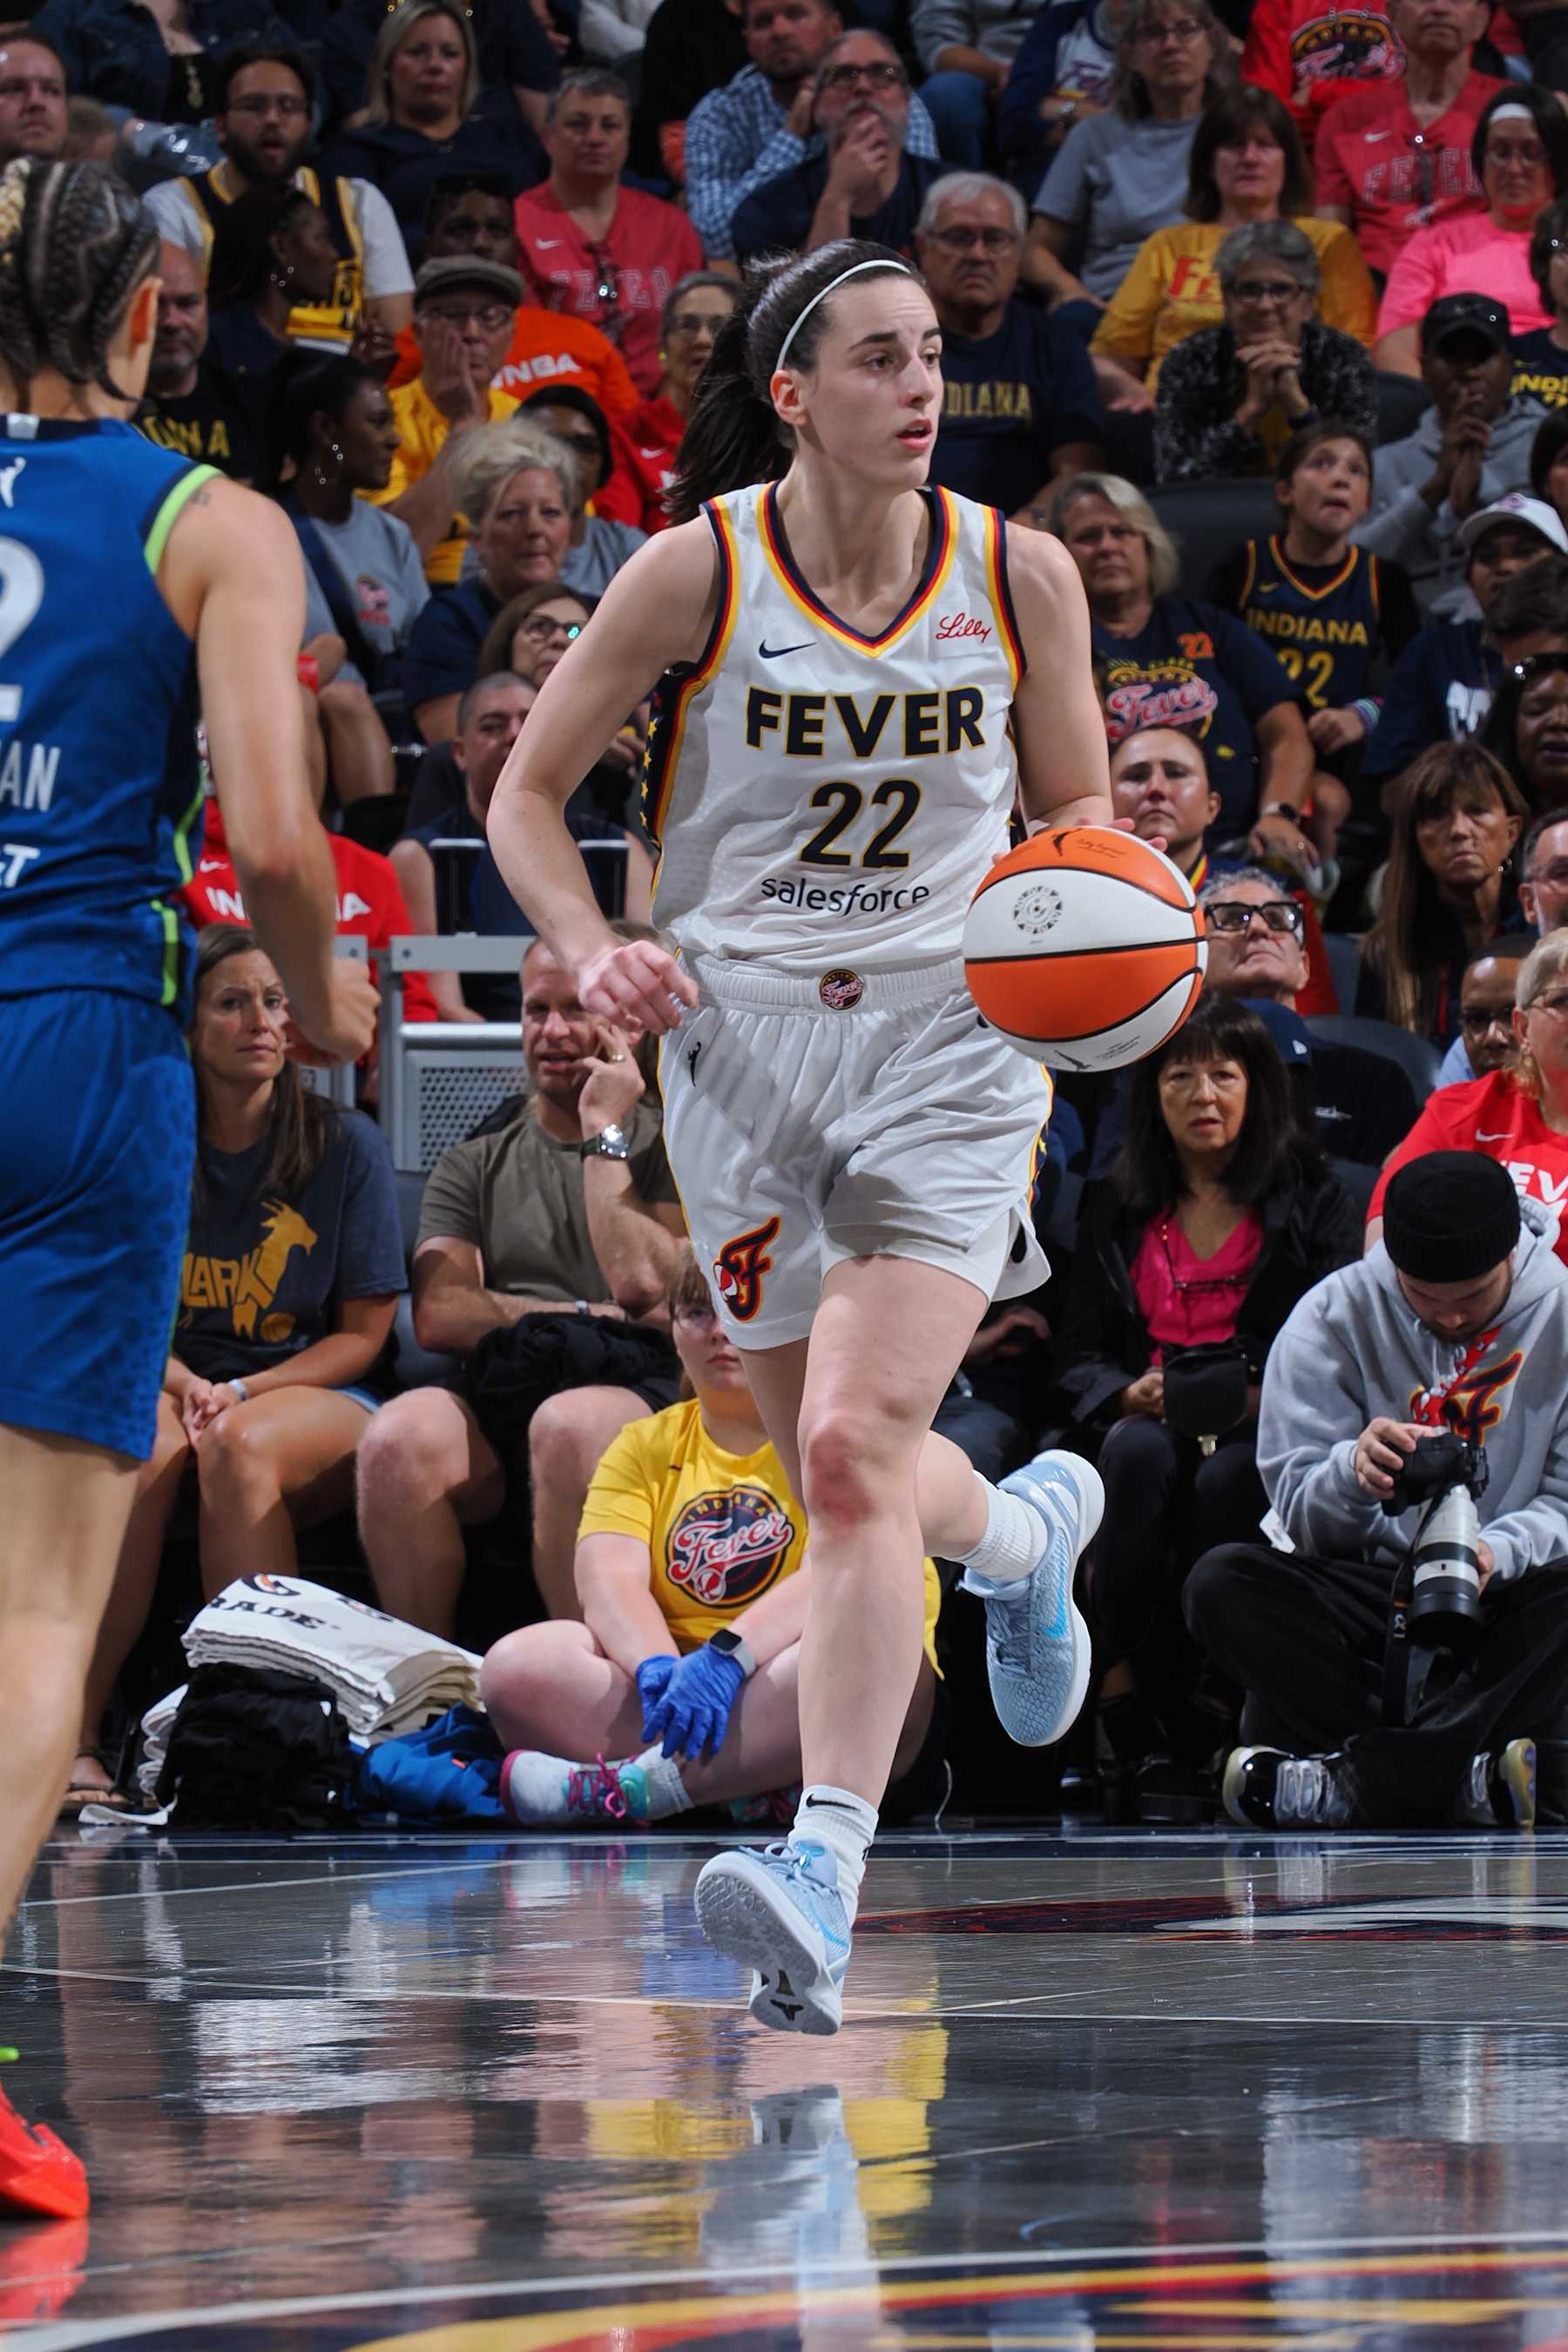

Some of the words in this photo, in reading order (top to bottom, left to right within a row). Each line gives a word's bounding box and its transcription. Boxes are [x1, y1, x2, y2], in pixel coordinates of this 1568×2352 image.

[941, 381, 1031, 418] DIANA
[936, 612, 991, 643] Lilly
[1247, 607, 1369, 647] INDIANA
[745, 684, 987, 760] FEVER
[796, 776, 922, 869] 22
[760, 876, 930, 916] salesforce
[1499, 1159, 1568, 1204] EV
[181, 1247, 274, 1310] LARK
[667, 1511, 795, 1585] Fever
